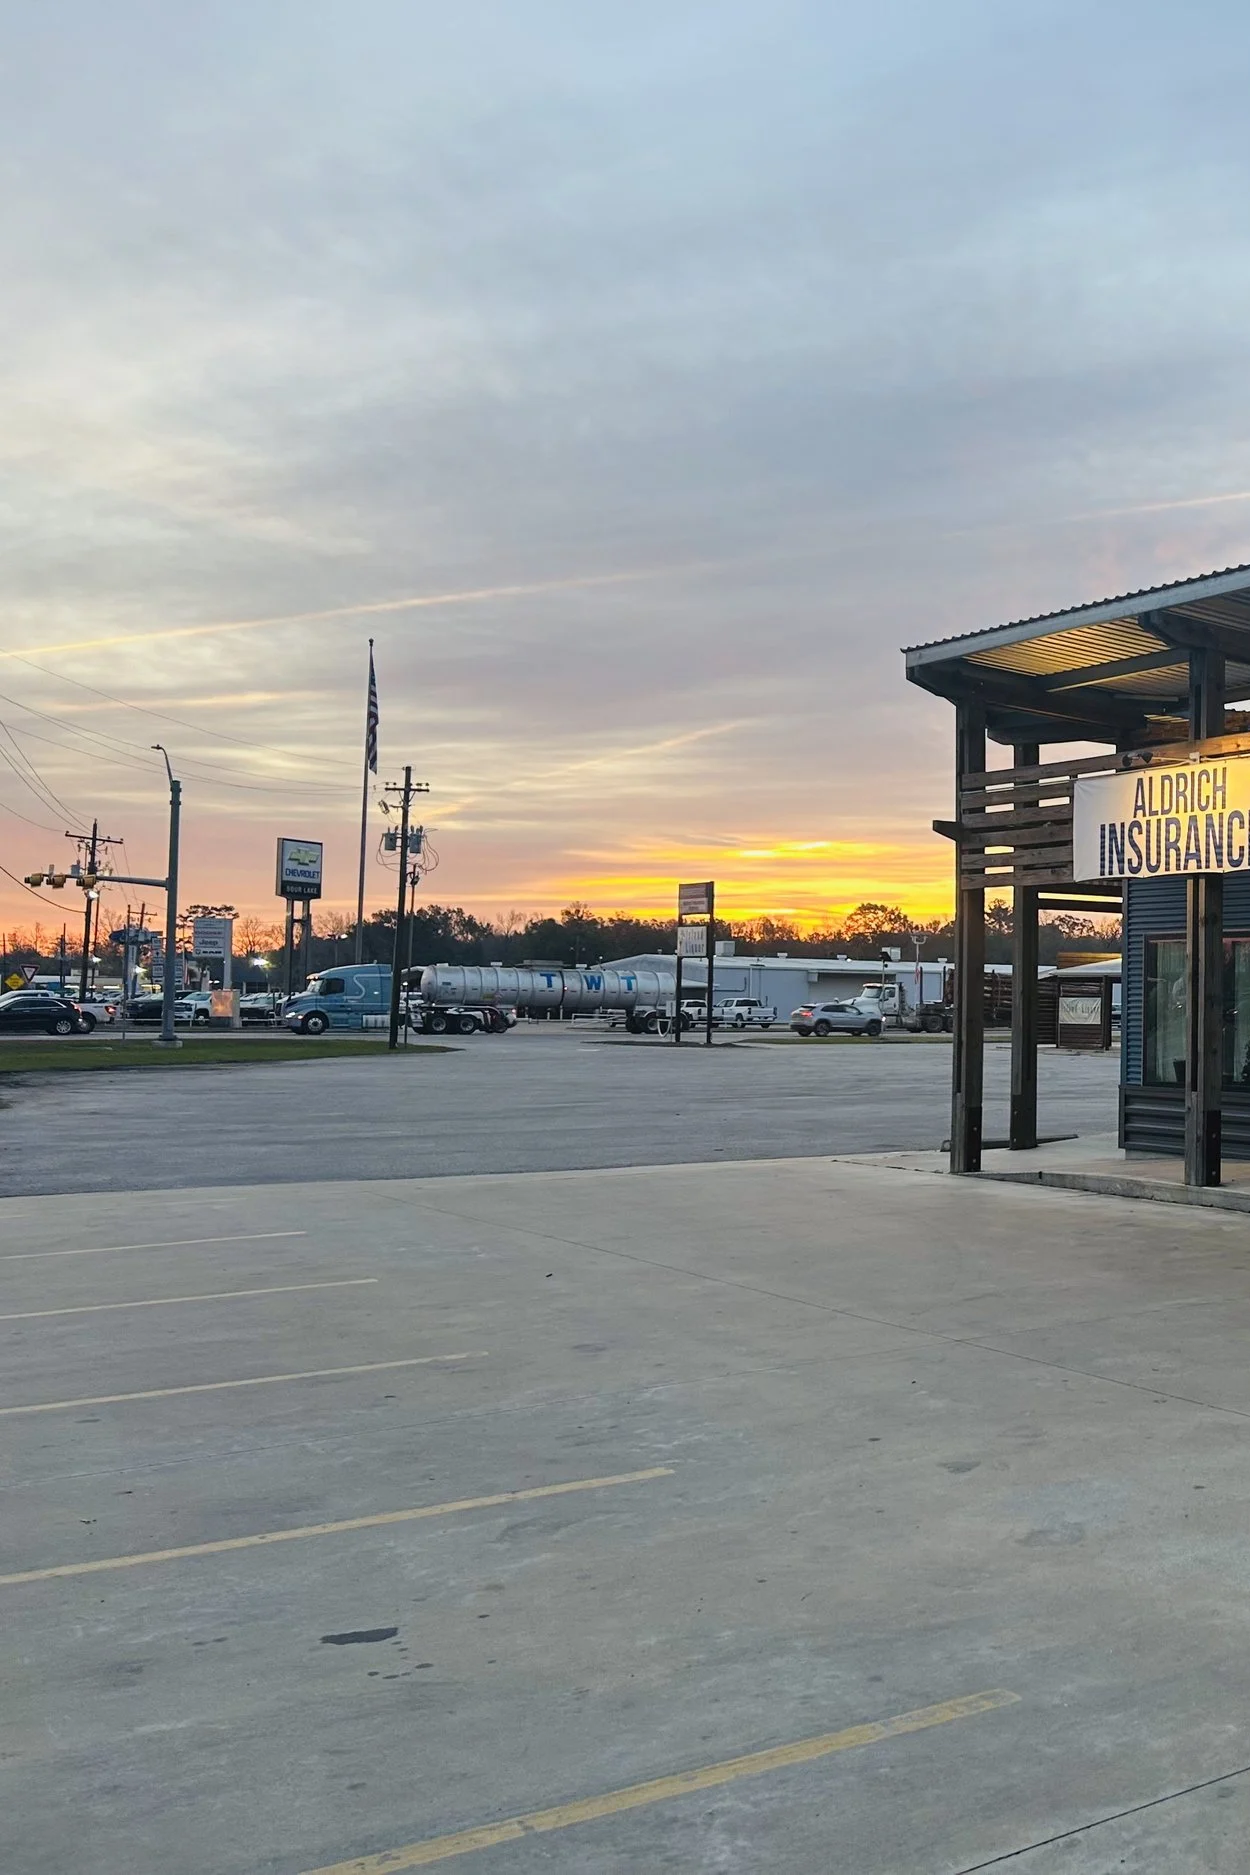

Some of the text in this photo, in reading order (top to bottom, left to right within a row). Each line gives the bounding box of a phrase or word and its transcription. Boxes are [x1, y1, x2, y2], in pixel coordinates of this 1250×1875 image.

[1133, 767, 1227, 818] ALDRICH
[285, 868, 320, 879] CHEVROLET
[303, 887, 318, 895] LAKE
